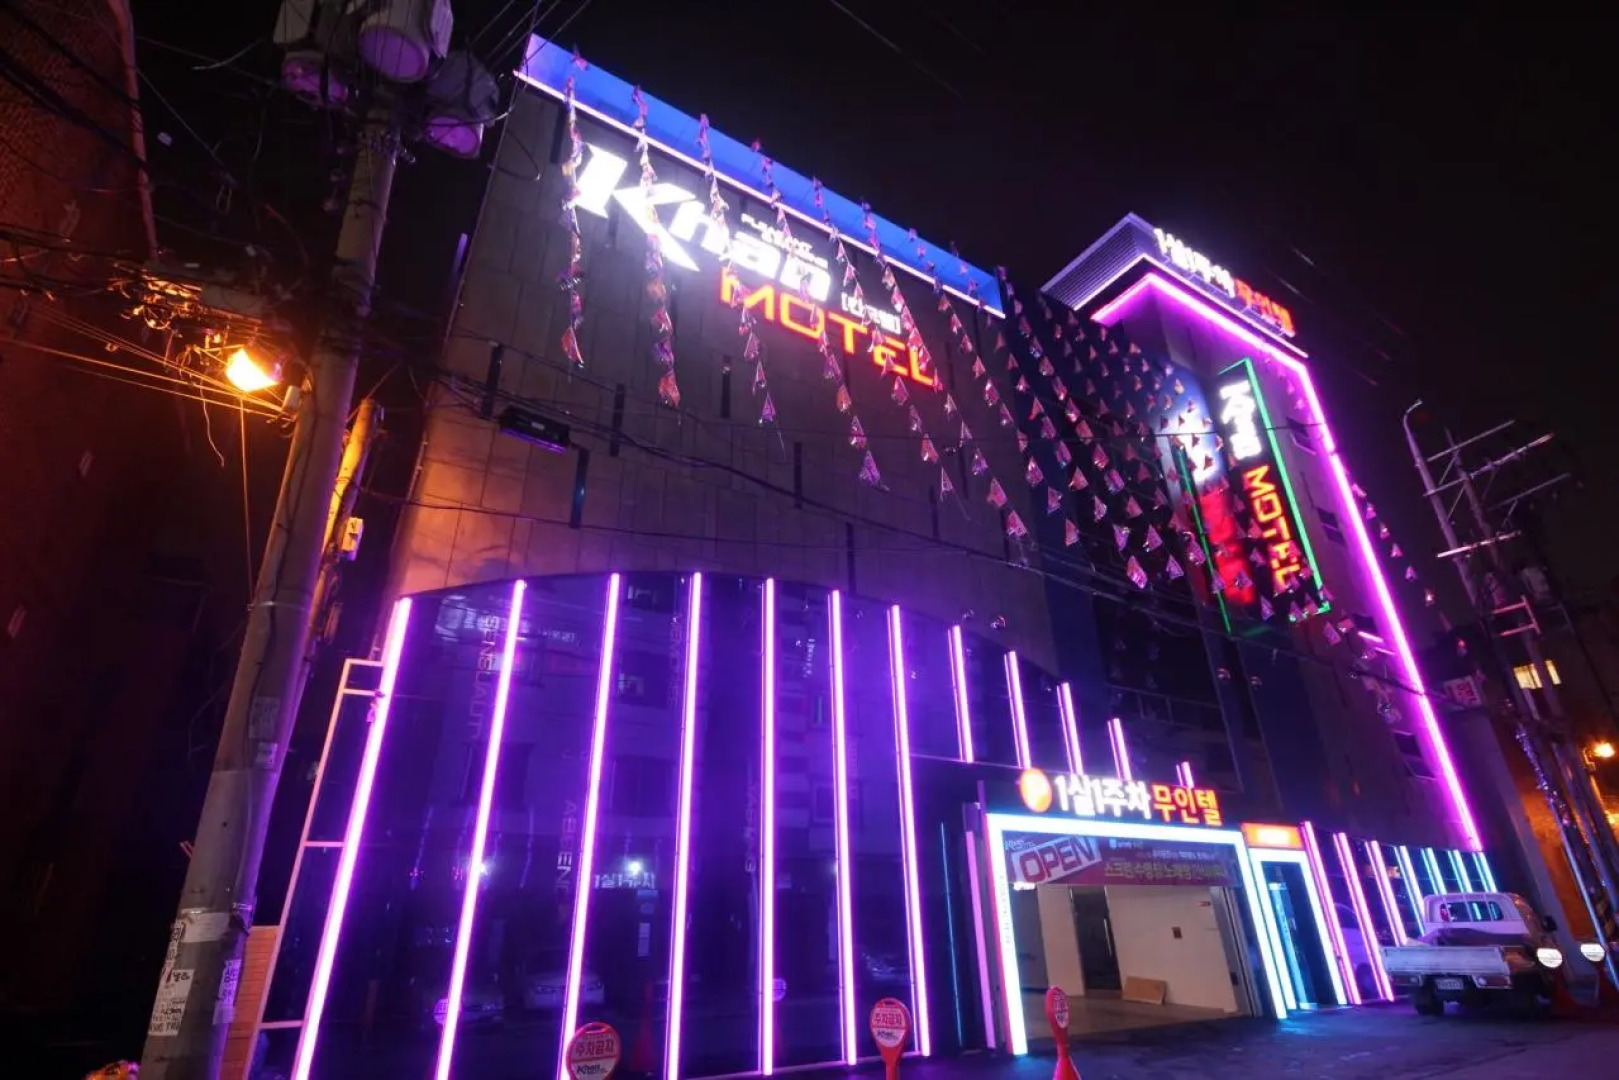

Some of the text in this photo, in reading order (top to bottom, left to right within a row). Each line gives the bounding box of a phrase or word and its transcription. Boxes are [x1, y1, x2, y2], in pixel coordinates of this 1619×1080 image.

[570, 142, 830, 302] Khan
[721, 265, 936, 388] MOTEL
[1246, 464, 1302, 590] MOTEL
[556, 799, 578, 897] ABSENC
[1054, 773, 1222, 827] 1실1주차 무인텔
[1018, 836, 1096, 883] OPEN
[575, 1038, 615, 1057] 주차금지
